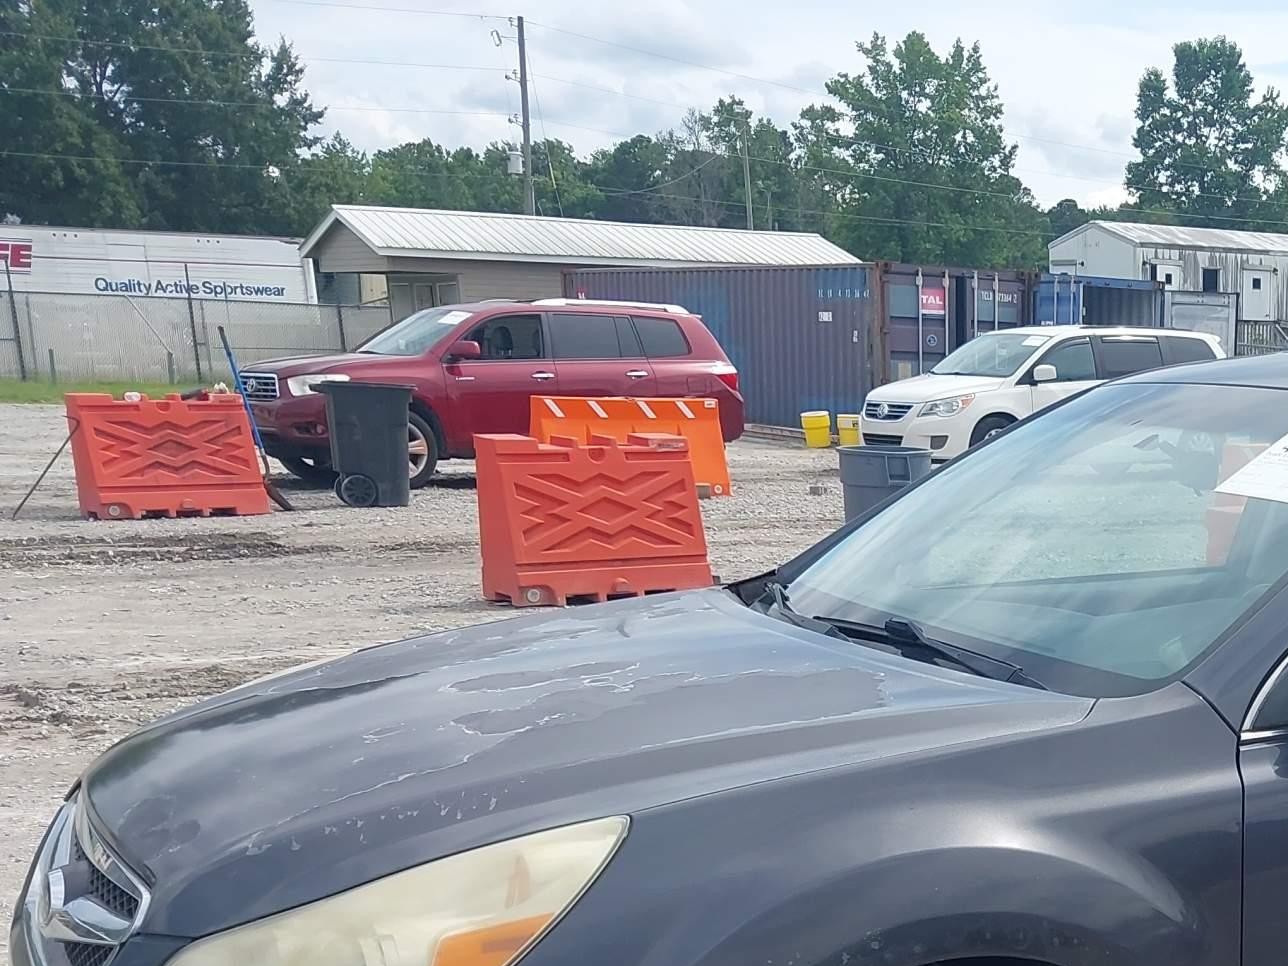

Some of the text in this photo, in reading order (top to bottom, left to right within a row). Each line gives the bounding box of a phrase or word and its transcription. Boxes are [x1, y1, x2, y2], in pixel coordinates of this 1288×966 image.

[94, 277, 286, 298] Quality Active Sportswear
[920, 294, 943, 305] TAL
